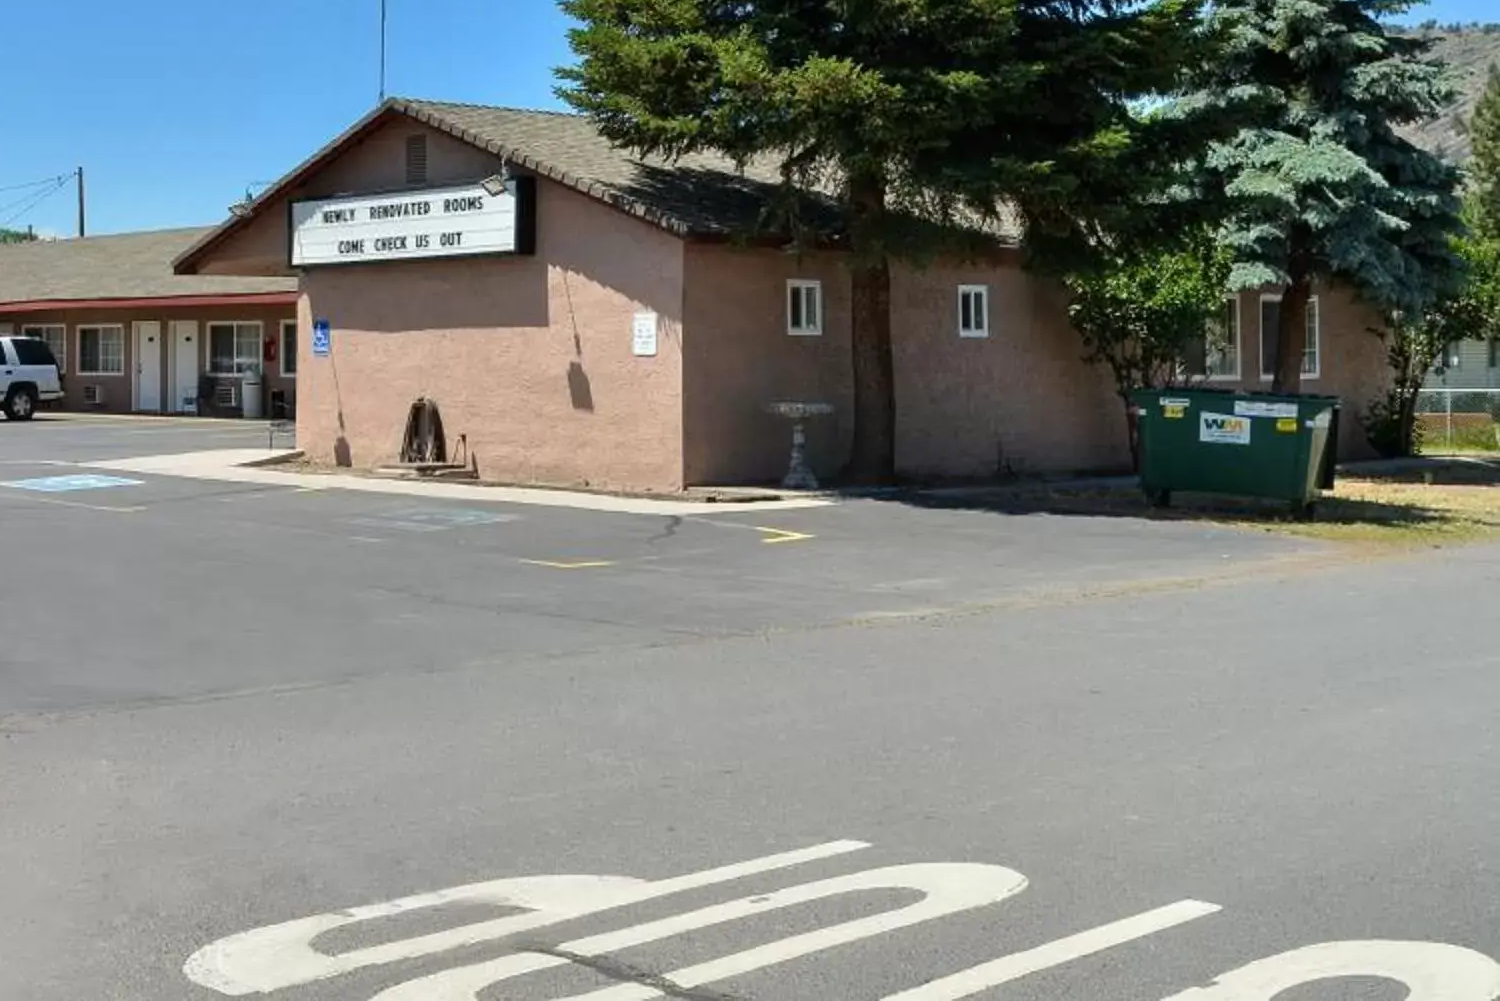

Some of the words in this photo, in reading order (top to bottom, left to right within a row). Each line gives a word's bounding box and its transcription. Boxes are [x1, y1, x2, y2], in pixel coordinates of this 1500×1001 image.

[322, 208, 357, 224] NEWLY
[369, 201, 431, 220] RENOVATED
[443, 196, 484, 214] ROOMS
[337, 240, 365, 255] COME
[373, 236, 408, 252] CHECK
[415, 234, 430, 248] US
[439, 232, 463, 247] OUT
